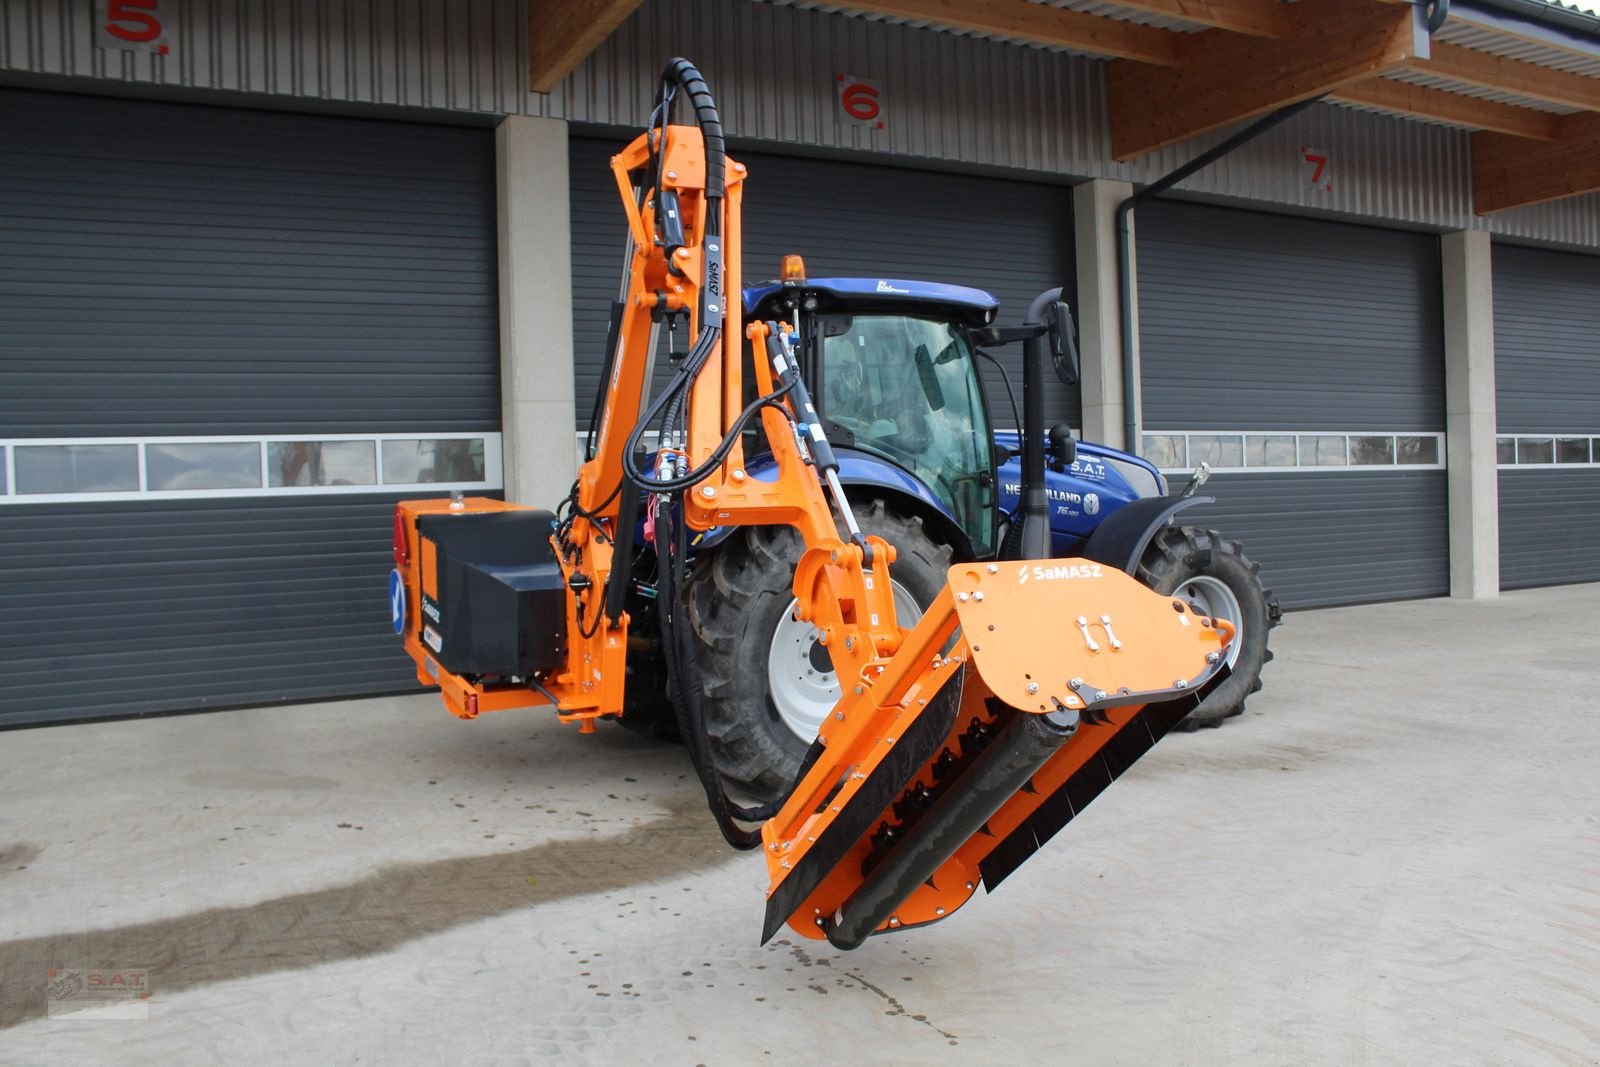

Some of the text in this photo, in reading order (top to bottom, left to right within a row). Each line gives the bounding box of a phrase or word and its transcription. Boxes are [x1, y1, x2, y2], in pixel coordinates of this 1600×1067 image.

[104, 0, 162, 43] 5
[842, 83, 880, 120] 6
[1305, 154, 1328, 183] 7
[708, 260, 719, 296] SaMASZ
[1071, 461, 1105, 476] S.A.T.
[1005, 483, 1021, 496] NE
[1032, 564, 1104, 581] SaMASZ
